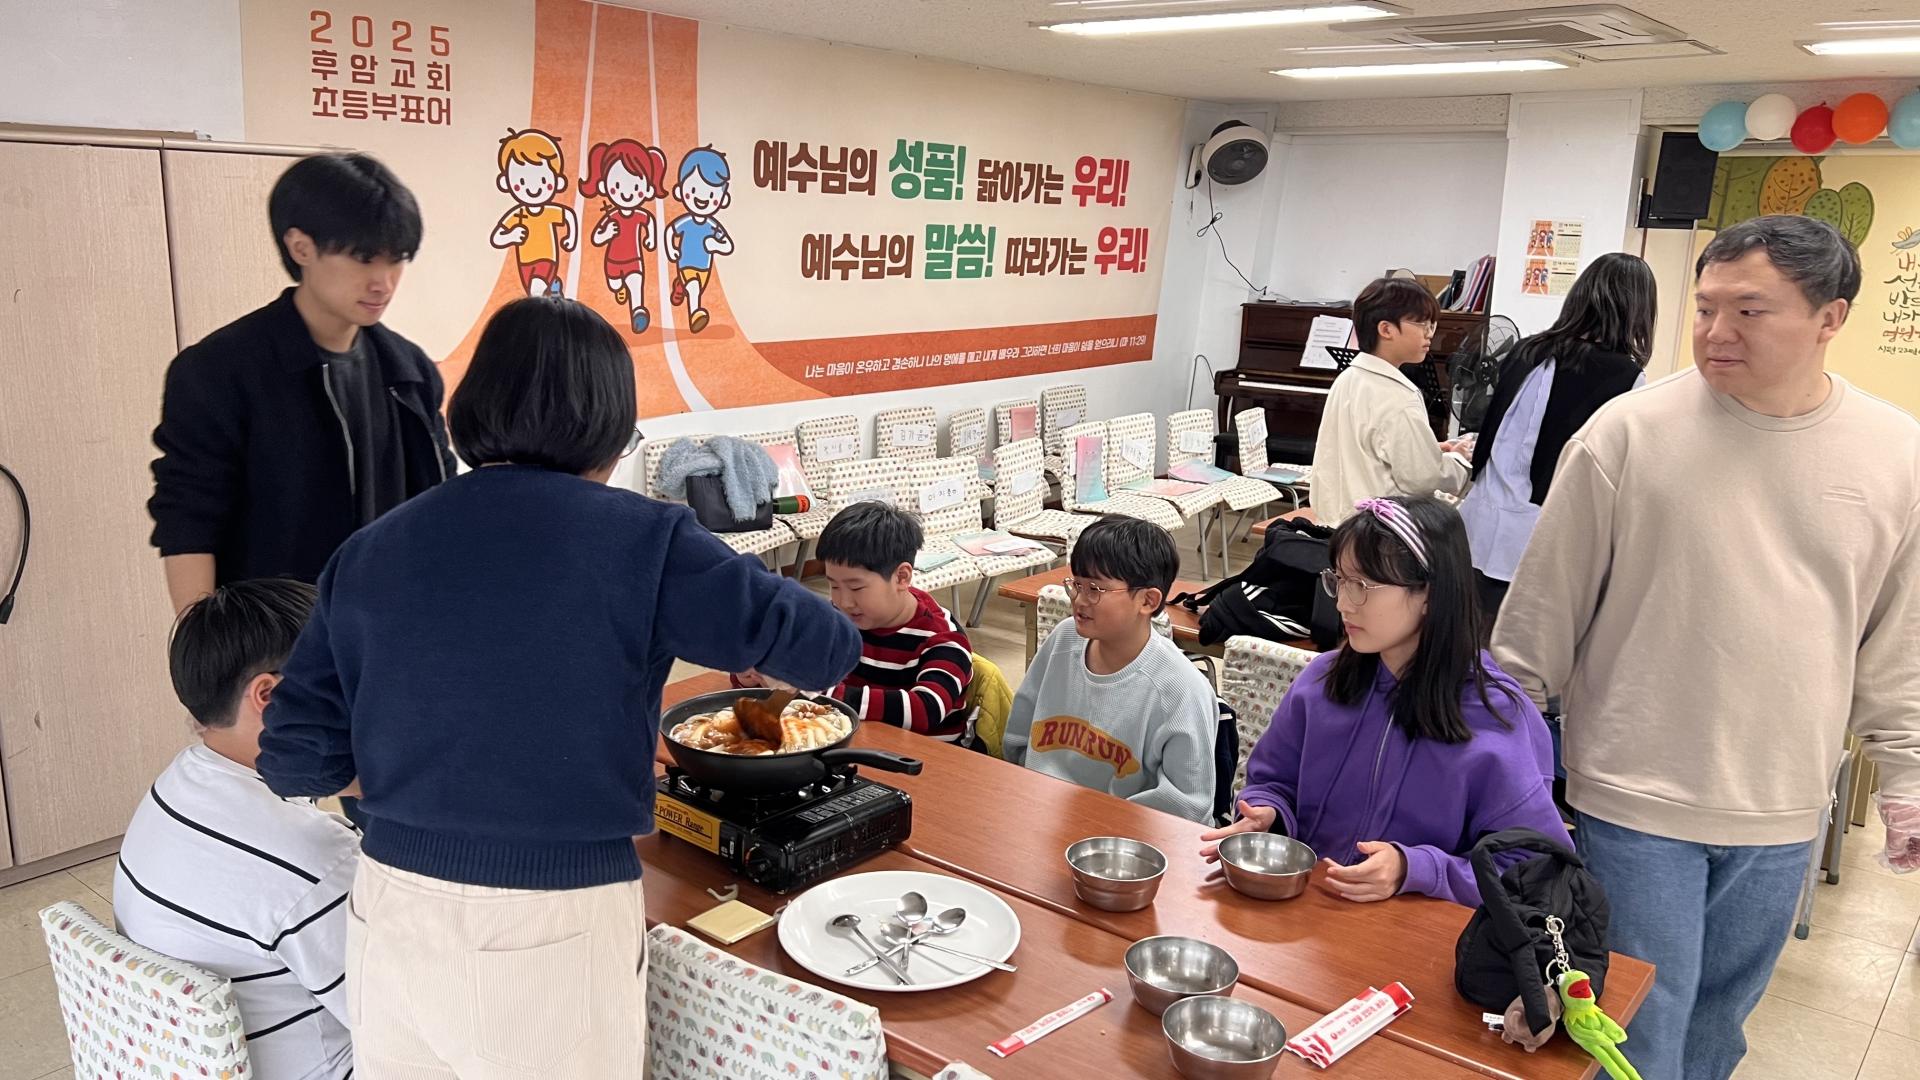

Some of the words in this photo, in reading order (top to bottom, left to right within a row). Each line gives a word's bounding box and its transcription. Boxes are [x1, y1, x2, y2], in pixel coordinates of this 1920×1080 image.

[310, 10, 450, 57] 2025
[312, 49, 451, 92] 후암교회
[312, 86, 451, 125] 초등부표어
[752, 138, 877, 196] 예수님의
[889, 138, 967, 201] 성품!
[977, 158, 1064, 204] 닮아가는
[1071, 155, 1130, 207] 우리!
[801, 232, 914, 281] 예수님의
[924, 223, 996, 280] 말씀!
[1005, 237, 1088, 276] 따라가는
[1093, 226, 1149, 275] 우리!
[1883, 272, 1920, 293] 선
[805, 364, 825, 378] 나는
[826, 361, 854, 376] 마음이
[856, 358, 890, 374] 온유하고
[891, 355, 925, 370] 겸손하니
[926, 354, 943, 366] 나의
[943, 352, 966, 366] 멍에를
[967, 350, 981, 363] 메고
[982, 349, 998, 361] 내게
[998, 347, 1020, 360] 배우라
[1020, 345, 1047, 358] 그리하면
[1048, 343, 1061, 355] 너희
[1061, 341, 1080, 353] 마음이
[1081, 339, 1094, 351] 쉼을
[1094, 337, 1119, 350] 얻으리니
[659, 805, 683, 824] POWER
